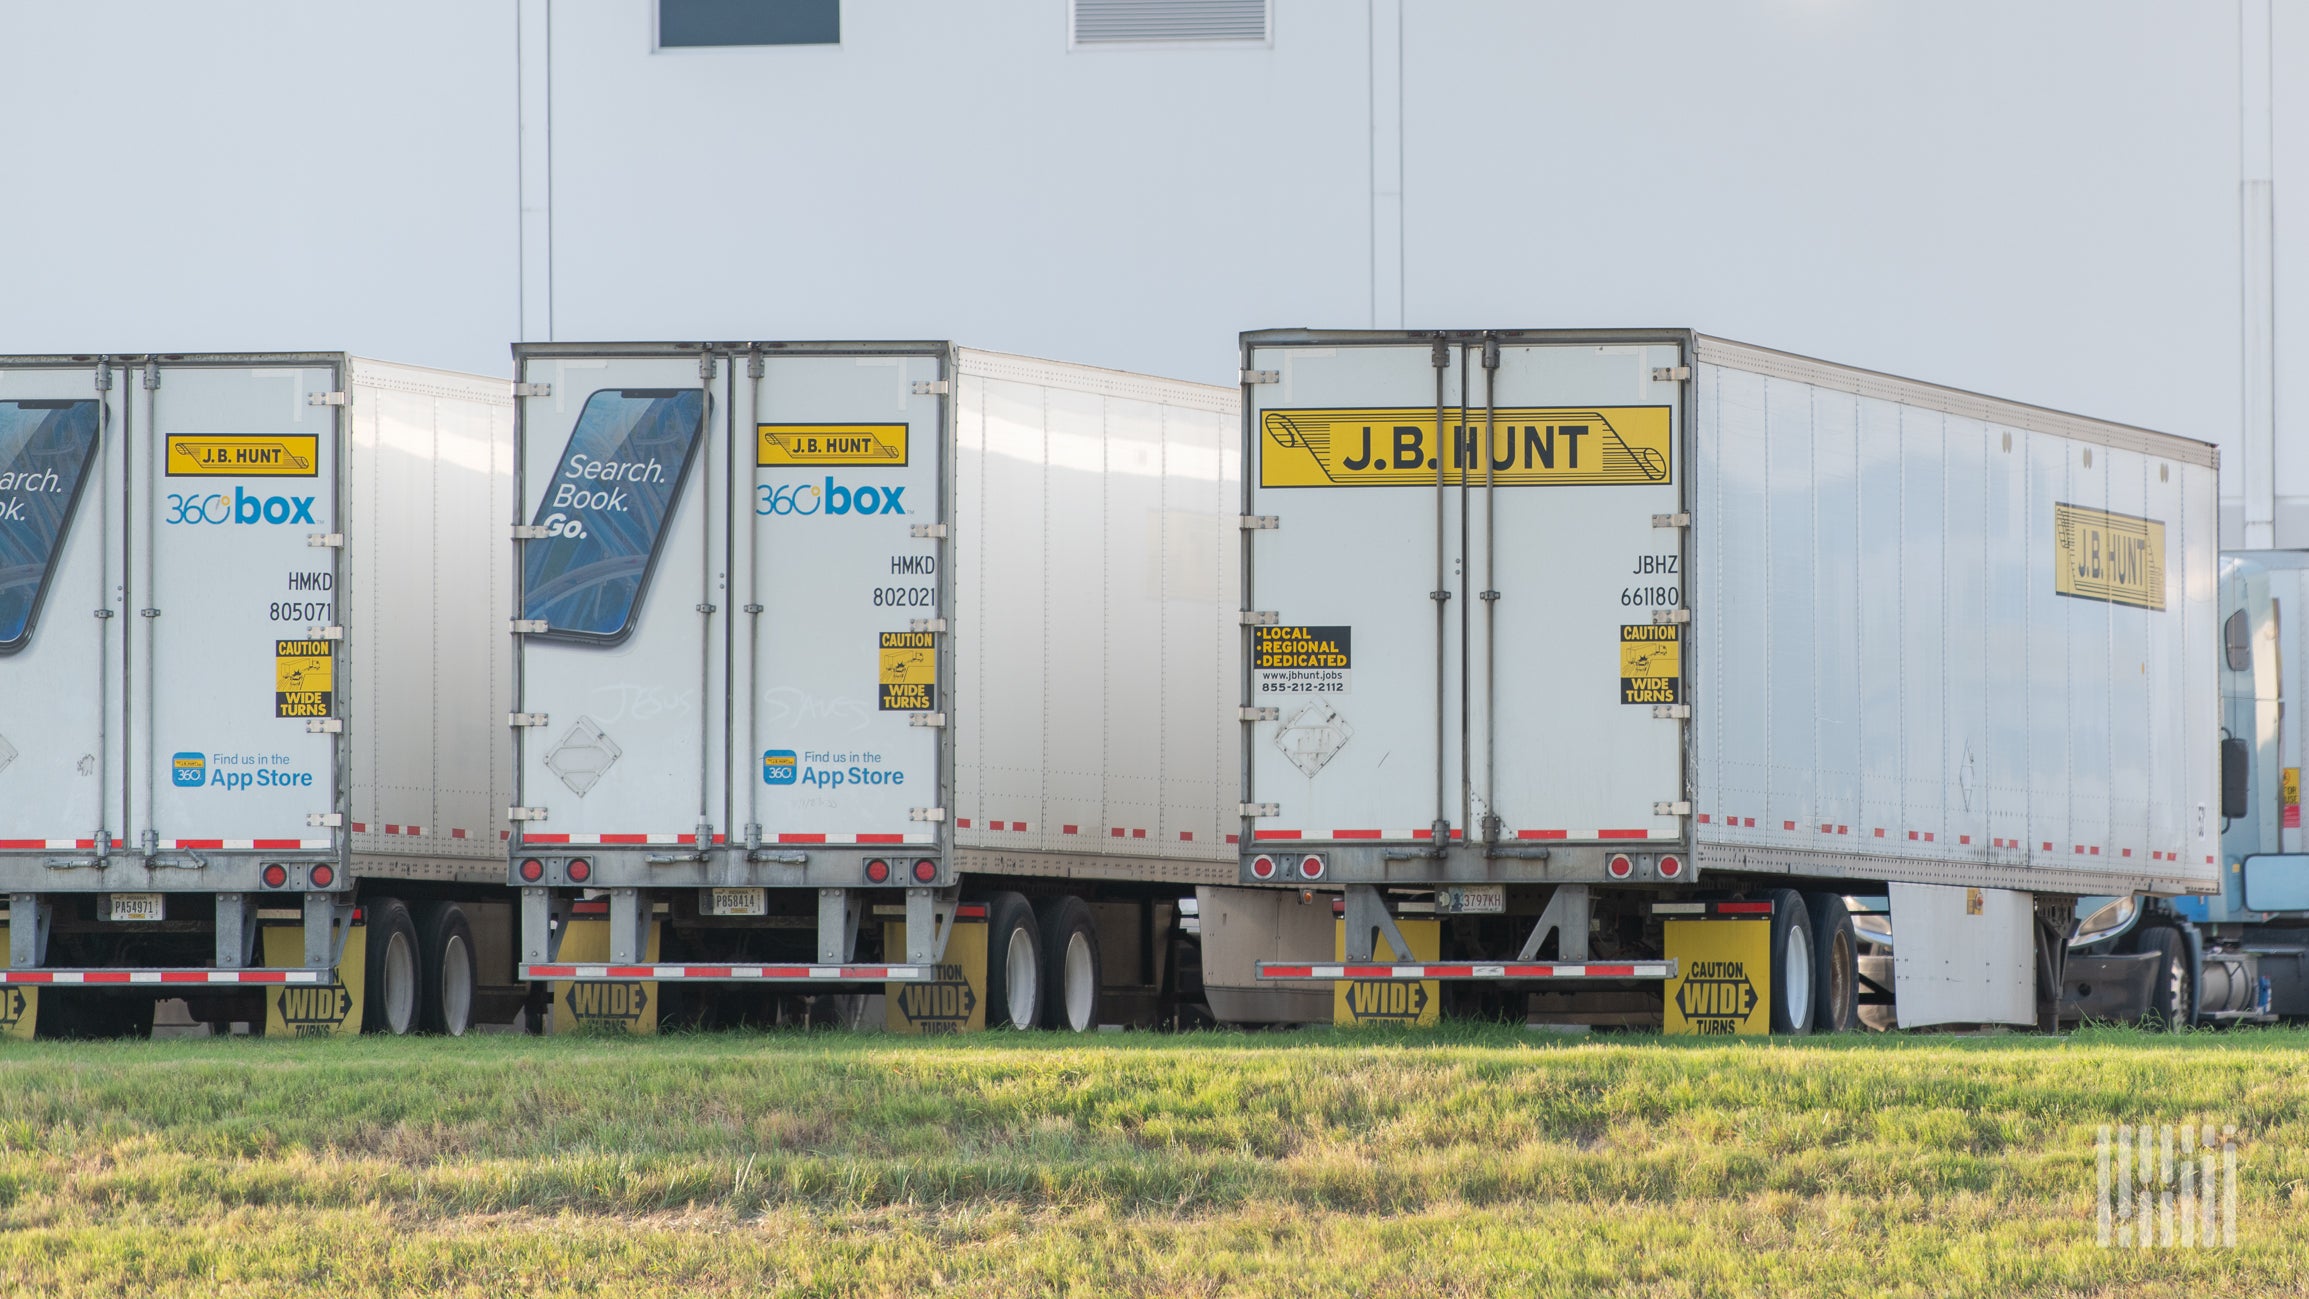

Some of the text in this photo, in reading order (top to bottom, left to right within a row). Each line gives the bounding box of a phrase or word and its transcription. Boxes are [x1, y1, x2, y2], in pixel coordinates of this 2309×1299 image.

[793, 438, 871, 453] J.B. HUNT
[1343, 426, 1589, 471] J.B. HUNT
[202, 448, 281, 463] J.B. HUNT
[565, 454, 665, 483] Search.
[0, 468, 62, 493] arch.
[553, 483, 628, 512] Book.
[543, 513, 587, 539] Go.
[891, 556, 935, 575] HMKD
[1633, 555, 1678, 574] JBHZ
[2078, 528, 2145, 587] J.B. HUNT
[288, 572, 333, 591] HMKD
[873, 587, 935, 606] 802021
[1621, 586, 1679, 606] 661180
[270, 602, 331, 621] 805071
[882, 633, 933, 647] CAUTION
[1262, 627, 1311, 639] LOCAL
[1623, 626, 1676, 640] CAUTION
[278, 641, 329, 655] CAUTION
[1262, 641, 1339, 653] REGIONAL
[1262, 655, 1347, 667] DEDICATED
[1262, 670, 1343, 681] www.jbhunt.jobs
[889, 684, 925, 696] WIDE
[1262, 683, 1344, 692] 855-212-2112
[1631, 678, 1669, 690] WIDE
[285, 692, 322, 704] WIDE
[883, 696, 930, 709] TURNS
[1626, 690, 1674, 702] TURNS
[280, 703, 327, 716] TURNS
[213, 753, 238, 765] Find
[241, 756, 255, 765] us
[258, 753, 268, 765] in
[271, 753, 290, 765] the
[805, 751, 830, 763] Find
[833, 754, 846, 763] us
[849, 751, 860, 763] in
[863, 751, 881, 763] the
[210, 769, 313, 791] App Store
[801, 766, 904, 789] App Store
[115, 900, 153, 914] PA54971
[935, 964, 962, 980] TION
[1691, 961, 1743, 978] CAUTION
[284, 988, 346, 1020] WIDE
[574, 983, 640, 1015] WIDE
[905, 985, 969, 1017] WIDE
[1353, 982, 1420, 1014] WIDE
[1683, 982, 1750, 1014] WIDE
[1696, 1020, 1735, 1035] TURNS
